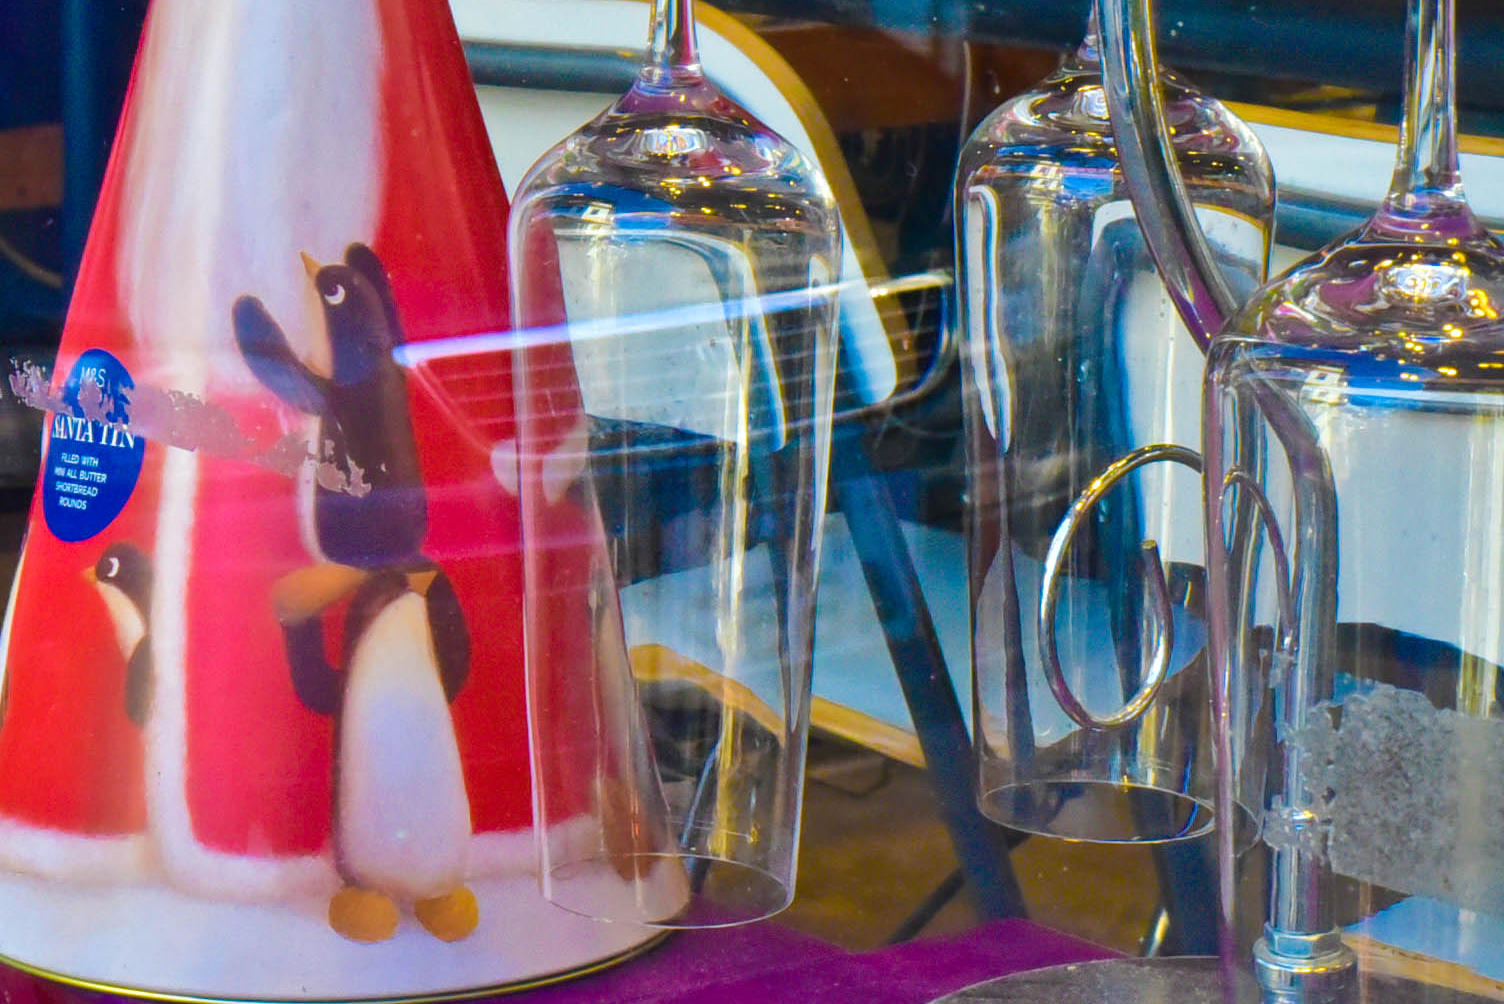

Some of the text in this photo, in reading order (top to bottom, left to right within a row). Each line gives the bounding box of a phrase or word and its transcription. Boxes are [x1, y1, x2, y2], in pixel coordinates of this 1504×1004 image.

[52, 413, 94, 444] SANTA
[98, 420, 136, 450] TIN
[81, 455, 99, 468] WITH
[79, 469, 108, 484] BUTTER
[55, 481, 99, 498] SHORTBREAD
[58, 495, 88, 511] ROUNDS
